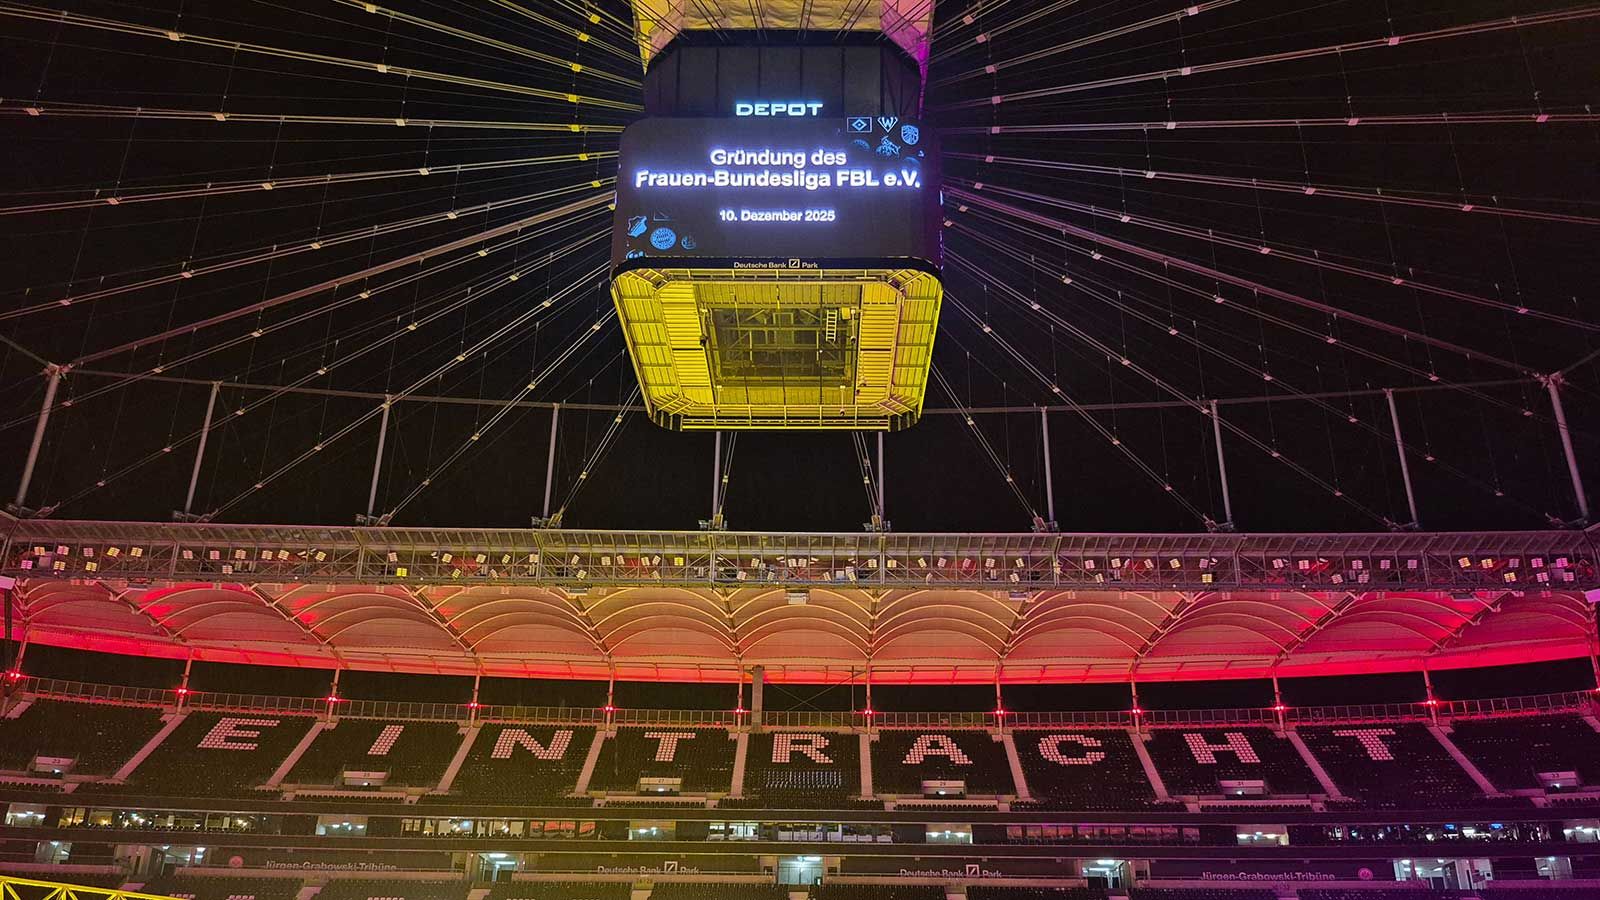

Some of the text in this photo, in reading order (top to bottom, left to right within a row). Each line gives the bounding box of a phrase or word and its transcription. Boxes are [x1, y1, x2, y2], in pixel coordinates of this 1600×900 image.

[735, 102, 823, 116] DEPOT
[710, 150, 847, 168] Gründung des
[635, 171, 921, 189] Frauen-Bundesliga FBL e.V.
[719, 210, 836, 222] 10. Dezember 2025
[266, 861, 397, 873] Jürgen-Grabowski-Tribüne
[597, 866, 638, 874] Deutsche
[640, 866, 662, 874] Bank
[900, 868, 941, 876] Deutsche
[943, 868, 965, 876] Bank
[1200, 872, 1336, 881] Jürgen-Grabowski-Tribüne
